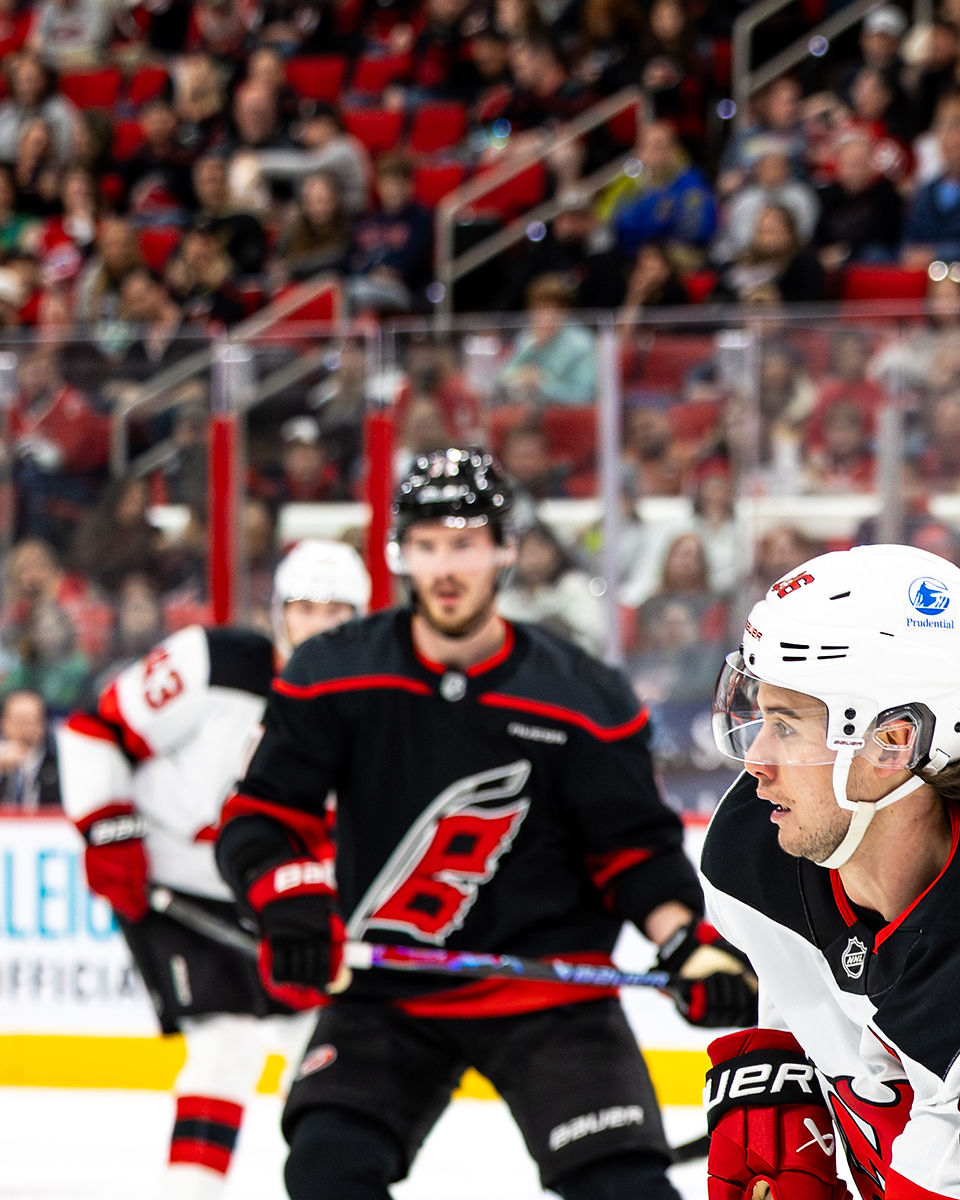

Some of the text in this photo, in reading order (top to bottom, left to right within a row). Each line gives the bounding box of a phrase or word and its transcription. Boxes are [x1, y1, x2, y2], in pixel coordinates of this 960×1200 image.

[906, 617, 955, 629] Prudential
[846, 953, 863, 965] NHL
[549, 1105, 644, 1150] BAUER
